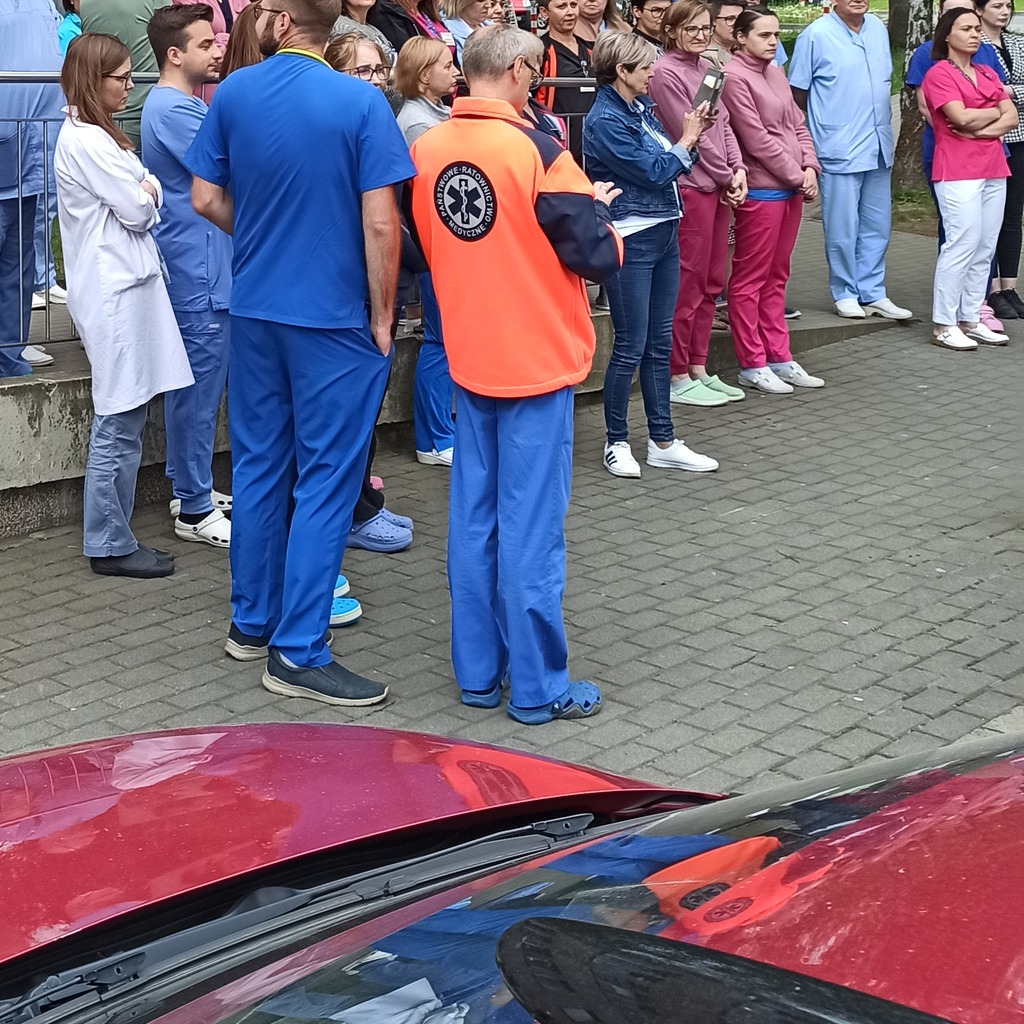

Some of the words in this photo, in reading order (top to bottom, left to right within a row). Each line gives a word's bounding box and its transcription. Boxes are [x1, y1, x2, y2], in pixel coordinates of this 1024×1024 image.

[436, 166, 458, 217] PAŃSTWOWE
[462, 166, 494, 222] RATOWNICTWO
[448, 220, 486, 237] MEDYCZNE
